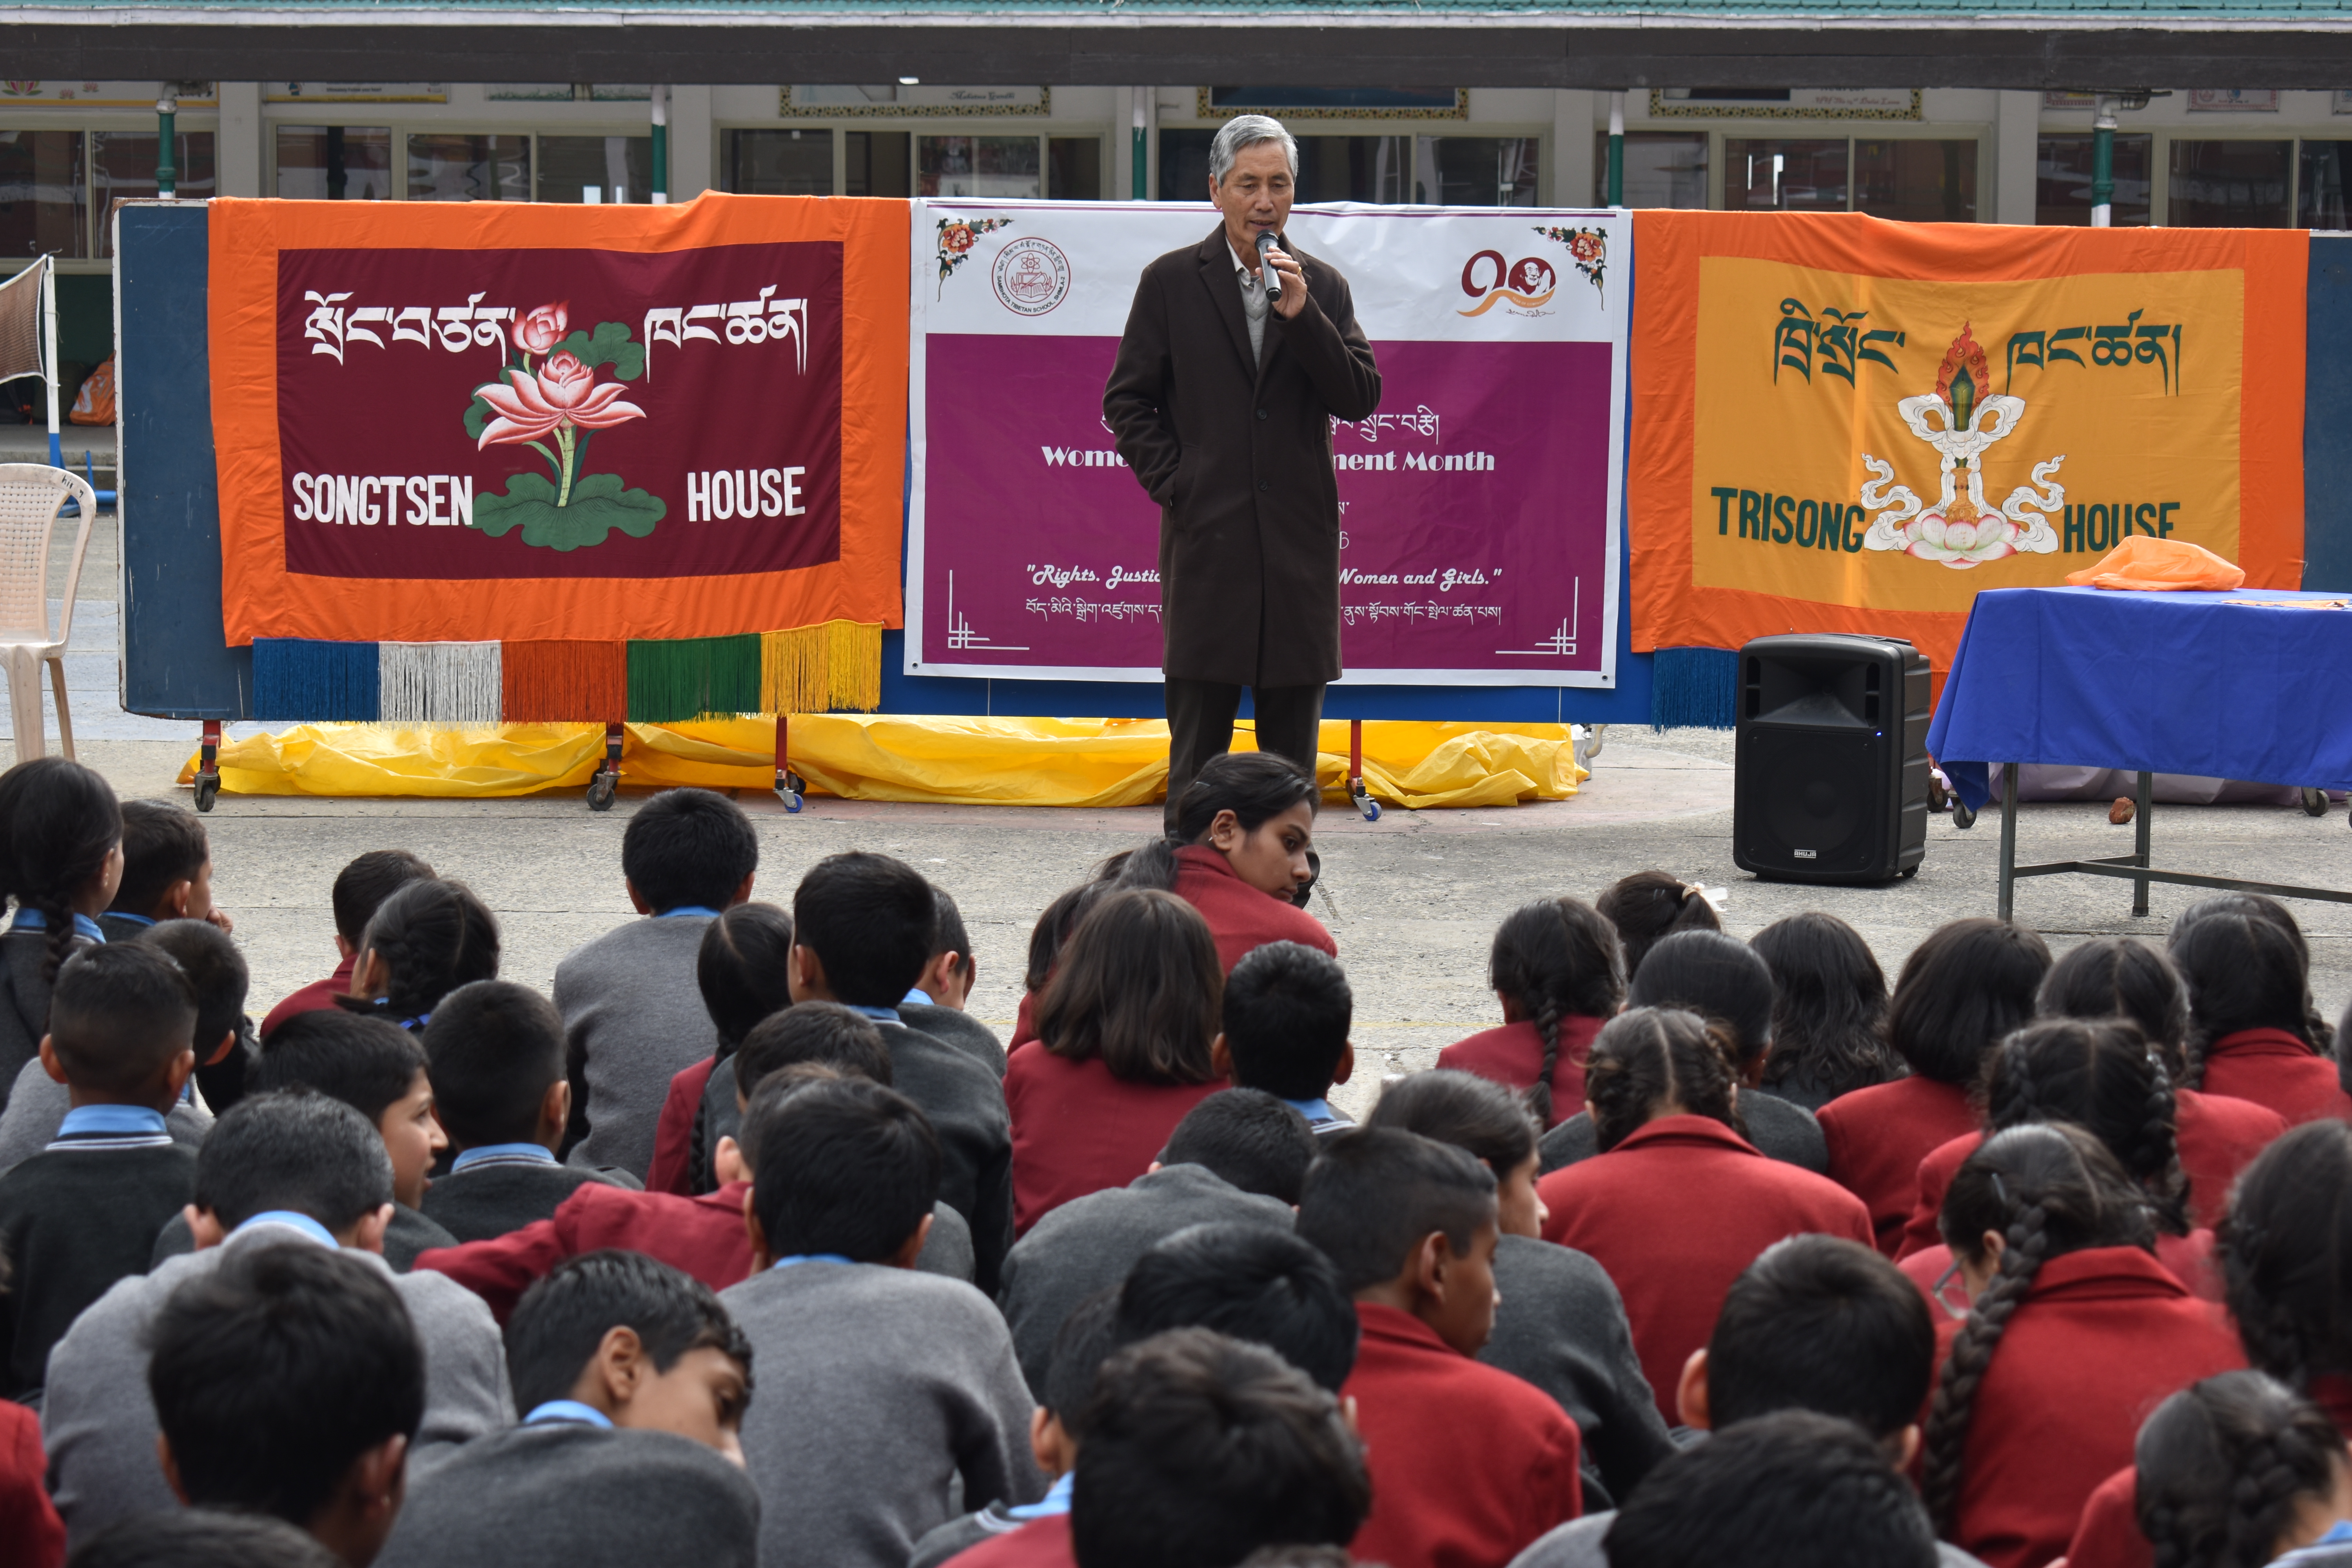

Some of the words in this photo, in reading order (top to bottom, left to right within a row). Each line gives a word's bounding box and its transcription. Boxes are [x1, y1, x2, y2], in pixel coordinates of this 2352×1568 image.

[997, 275, 1011, 304] SAMBHOTA
[1011, 301, 1032, 312] TIBETAN
[1054, 276, 1065, 300] SHIMLA-2
[1041, 446, 1129, 467] Wome
[1402, 451, 1495, 471] Month
[292, 472, 473, 526] SONGTSEN
[688, 466, 806, 522] HOUSE
[1711, 487, 1866, 553] TRISONG
[1105, 565, 1160, 590] Justic
[1403, 568, 1437, 584] and
